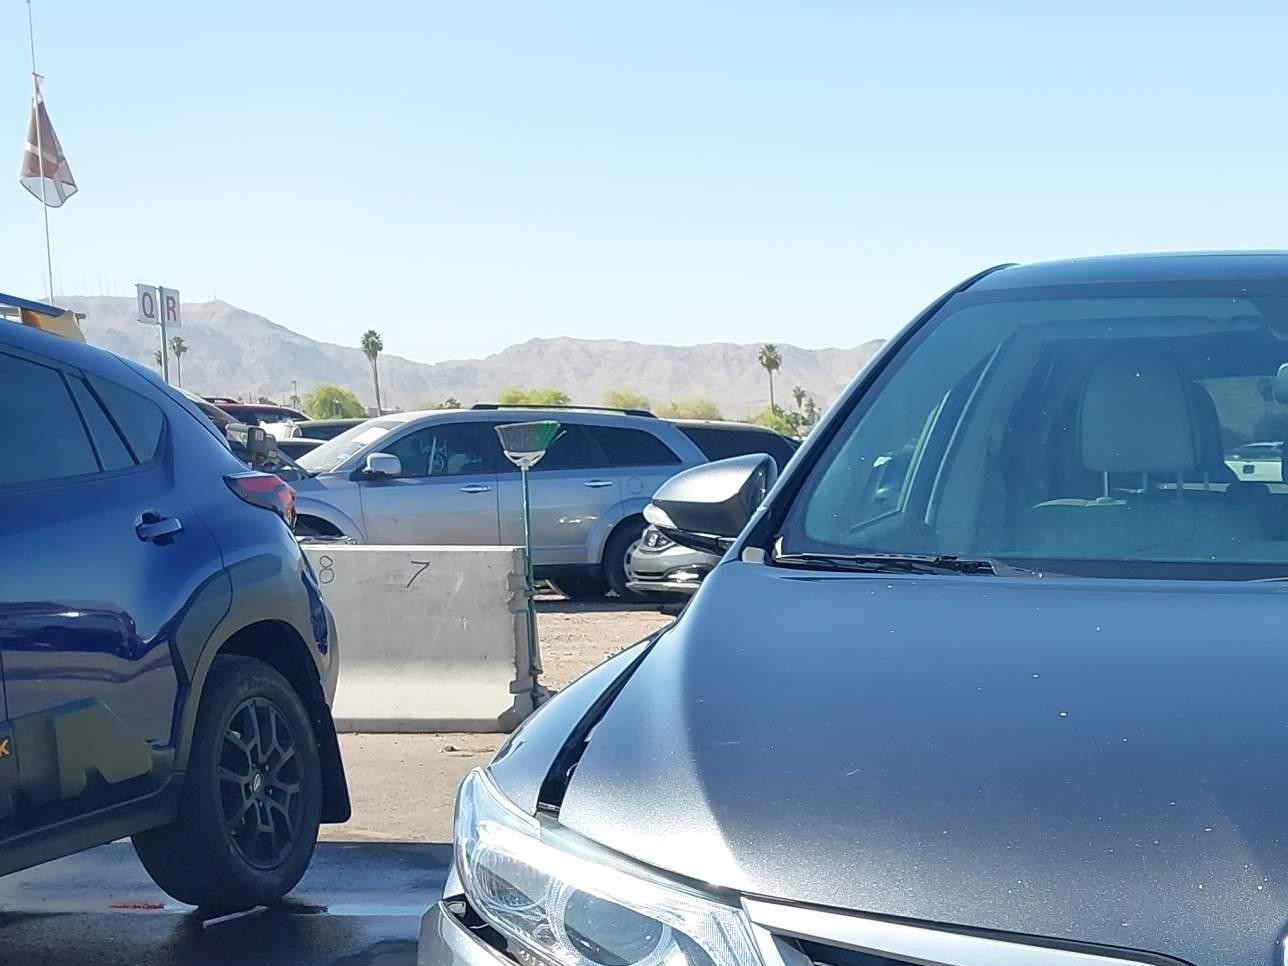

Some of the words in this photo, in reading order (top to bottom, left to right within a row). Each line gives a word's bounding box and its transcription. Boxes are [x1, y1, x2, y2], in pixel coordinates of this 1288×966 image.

[142, 292, 155, 318] Q
[166, 296, 177, 321] R
[319, 555, 334, 584] 8
[406, 560, 430, 588] 7
